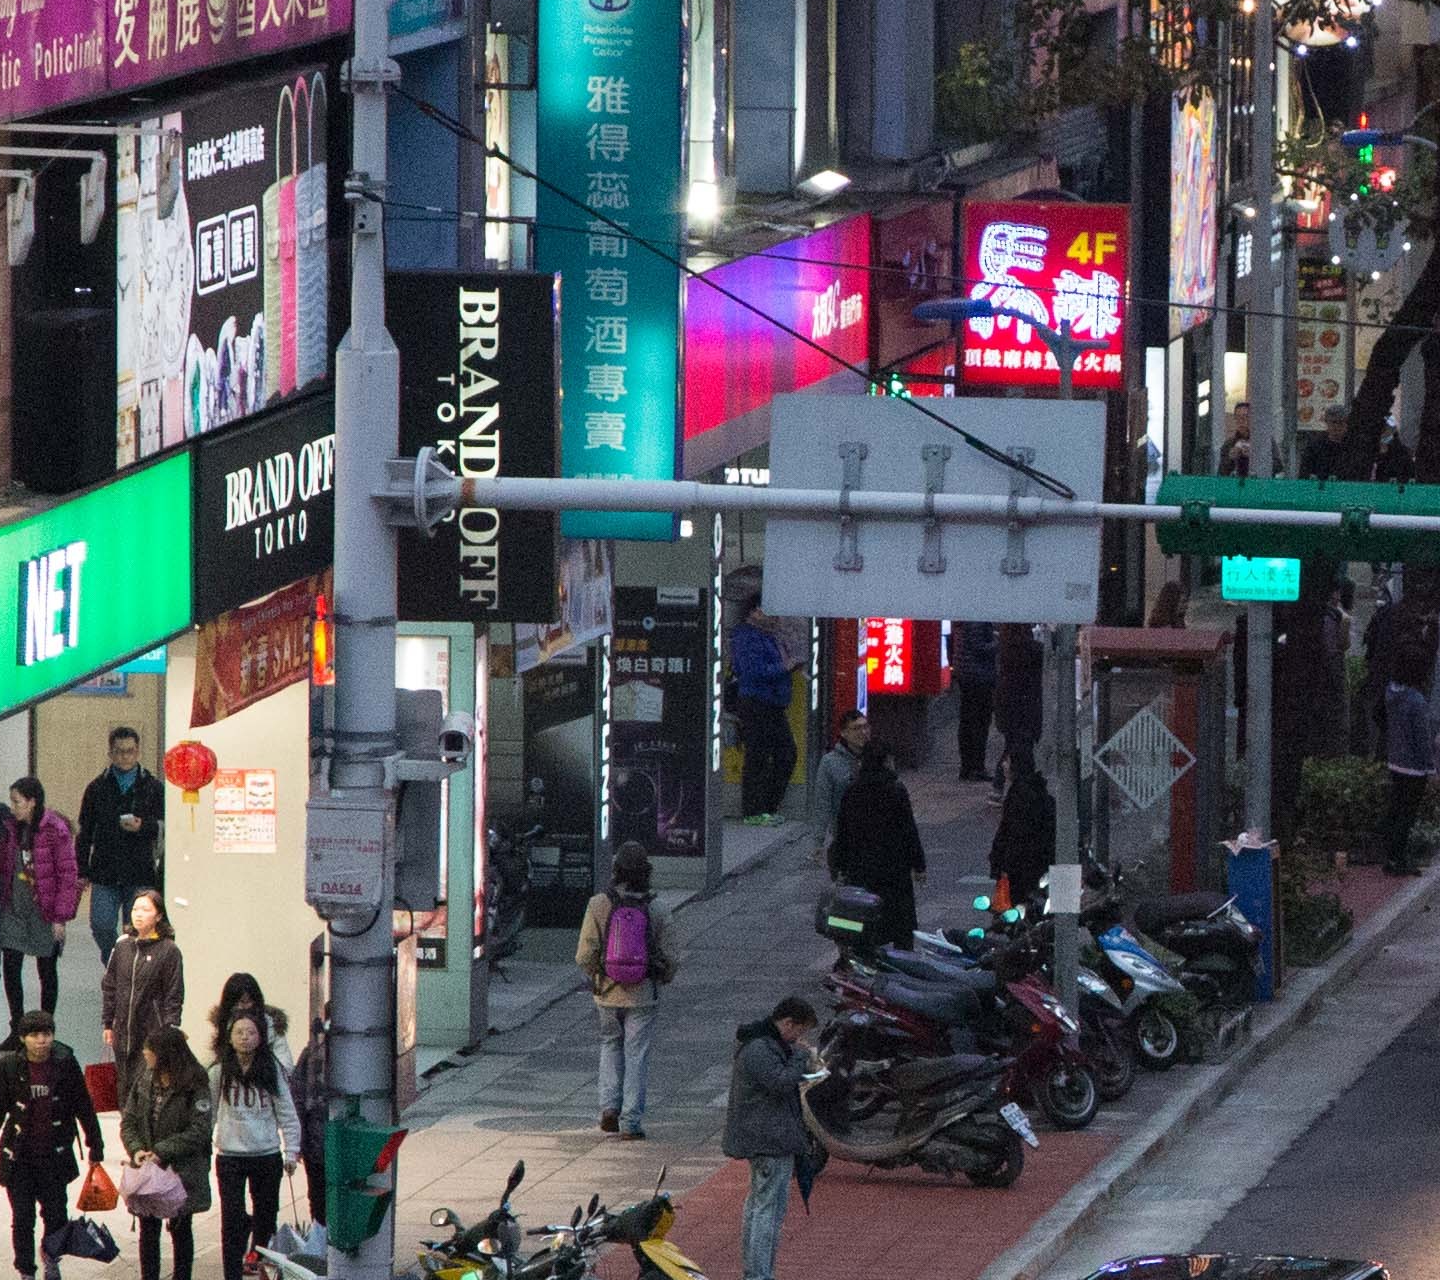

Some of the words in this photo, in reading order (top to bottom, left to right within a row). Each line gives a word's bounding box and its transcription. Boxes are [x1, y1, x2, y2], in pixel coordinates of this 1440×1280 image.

[34, 29, 104, 81] Policlinic
[1066, 231, 1118, 265] 4F
[459, 287, 501, 478] BRAND
[225, 449, 294, 532] BRAND
[254, 508, 308, 559] TOKYO
[458, 507, 500, 611] OFF
[18, 540, 88, 666] NET
